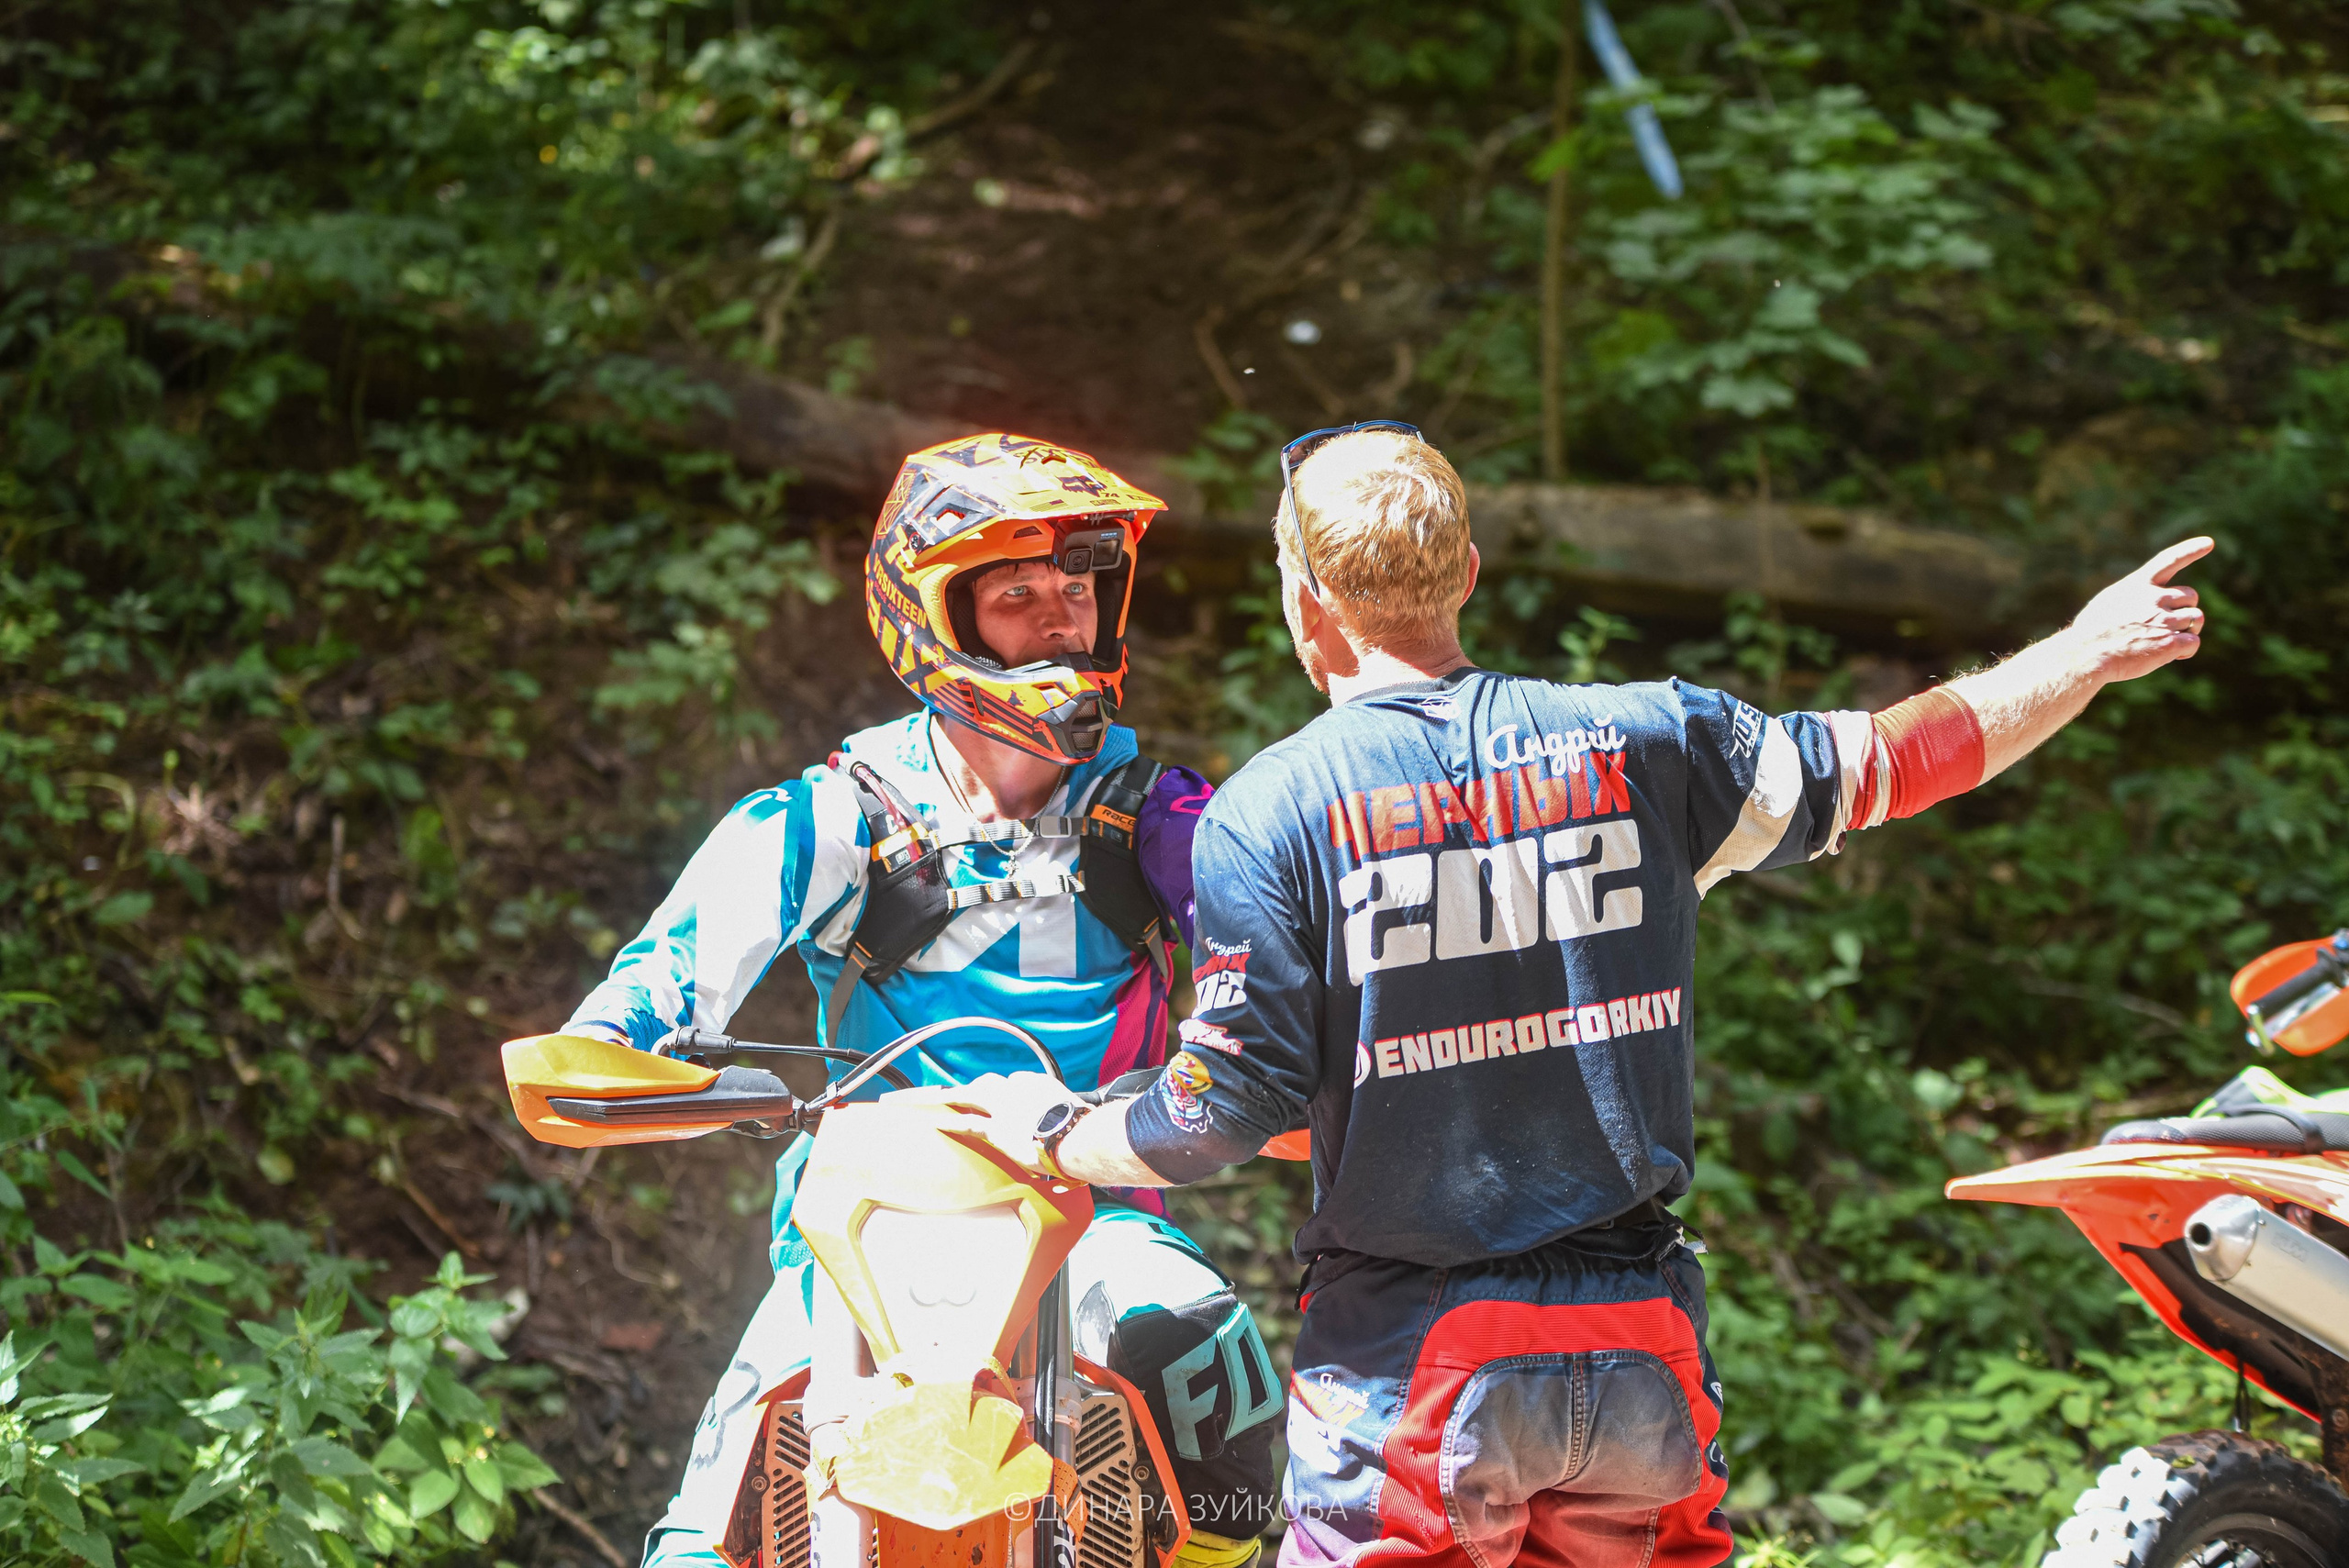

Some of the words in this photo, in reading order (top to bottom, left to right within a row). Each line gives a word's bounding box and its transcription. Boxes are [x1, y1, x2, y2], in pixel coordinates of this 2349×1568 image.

[1327, 751, 1631, 861] ЧЕРНЫХ
[1339, 819, 1642, 987] 202
[1375, 987, 1681, 1079] ENDUROGORKIY
[1162, 1303, 1285, 1462] FO
